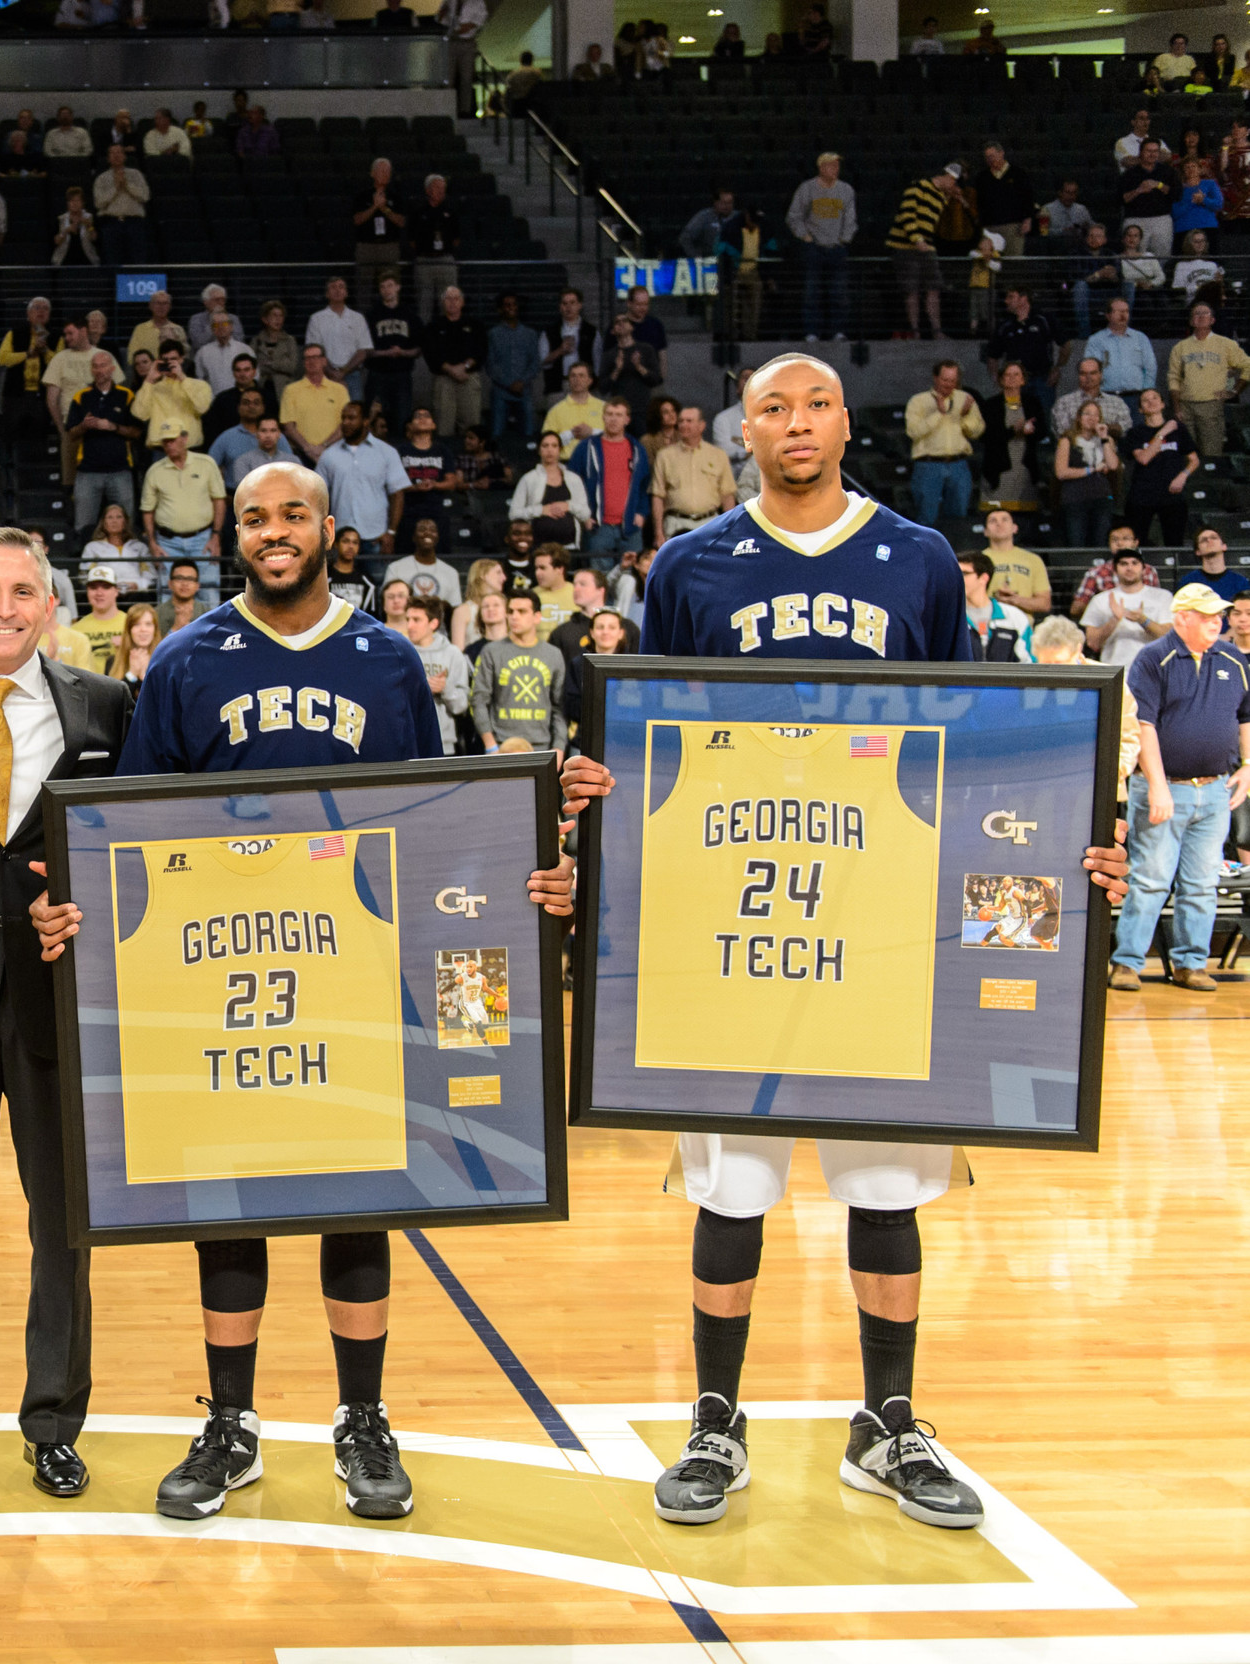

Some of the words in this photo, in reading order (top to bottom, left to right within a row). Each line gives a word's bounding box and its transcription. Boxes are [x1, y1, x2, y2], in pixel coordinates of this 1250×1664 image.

[127, 280, 158, 296] 109
[731, 592, 889, 658] TECH
[220, 685, 367, 755] TECH
[703, 798, 866, 852] GEORGIA
[982, 810, 1038, 845] GT
[435, 885, 488, 919] GT
[737, 858, 825, 920] 24
[182, 910, 339, 966] GEORGIA
[714, 932, 846, 982] TECH
[223, 968, 299, 1032] 23
[203, 1042, 328, 1091] TECH
